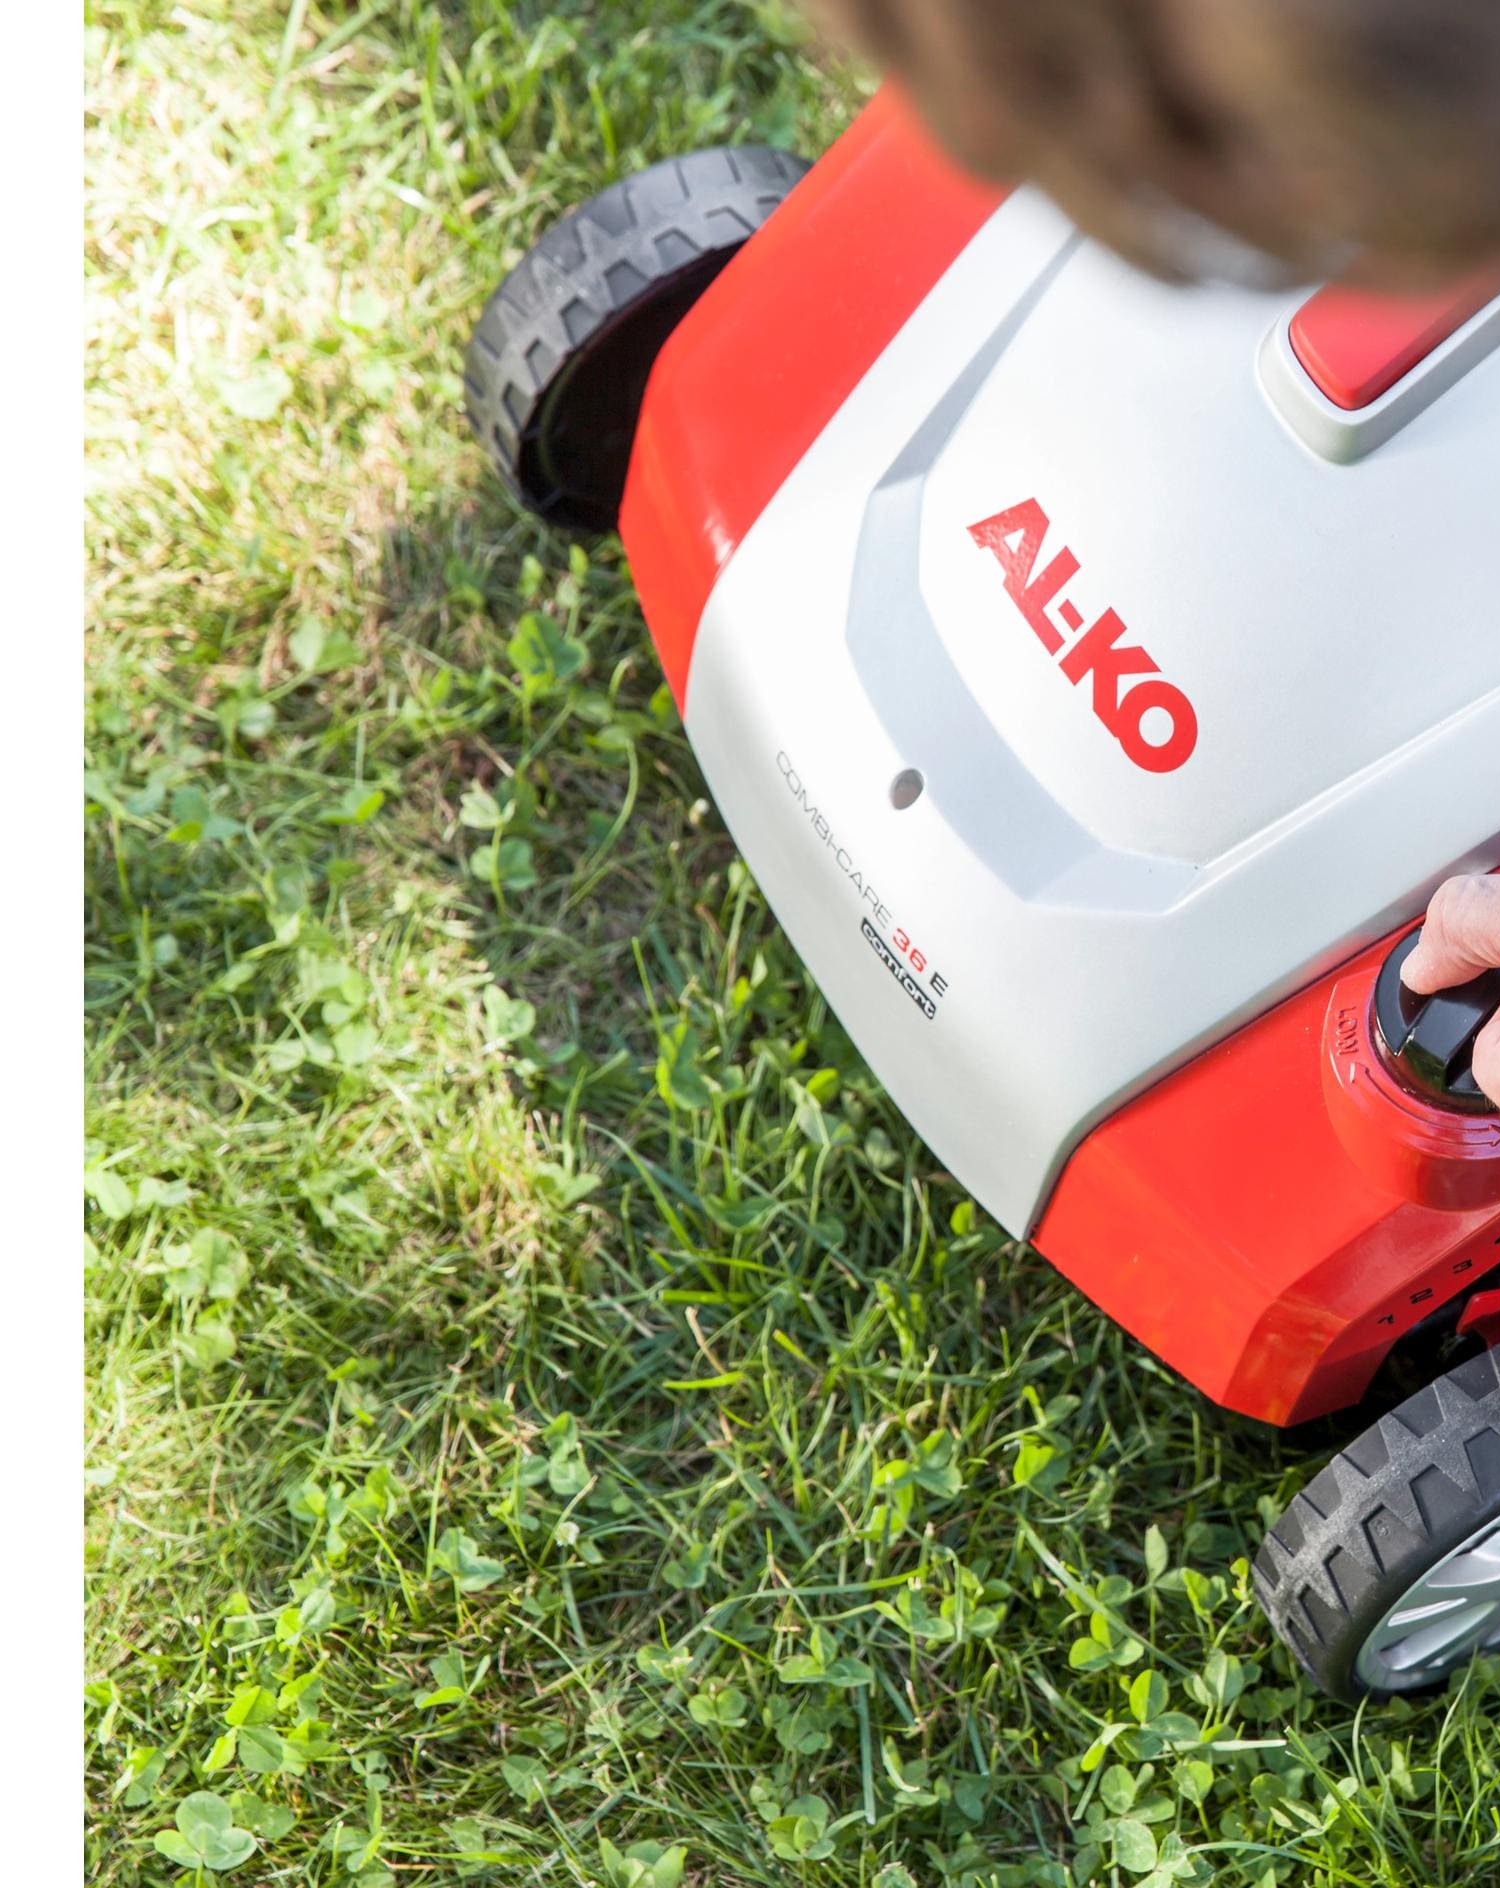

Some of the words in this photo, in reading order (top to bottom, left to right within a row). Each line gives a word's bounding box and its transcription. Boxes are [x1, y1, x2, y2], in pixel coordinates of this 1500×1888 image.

[966, 497, 1198, 773] AL-KO
[776, 750, 892, 929] COMBI-CARE
[892, 928, 927, 973] 36
[929, 971, 948, 997] E
[861, 917, 937, 1020] comfort
[1336, 1006, 1358, 1055] LOW
[1377, 1314, 1394, 1324] 1
[1409, 1287, 1433, 1304] 2
[1453, 1259, 1473, 1274] 3
